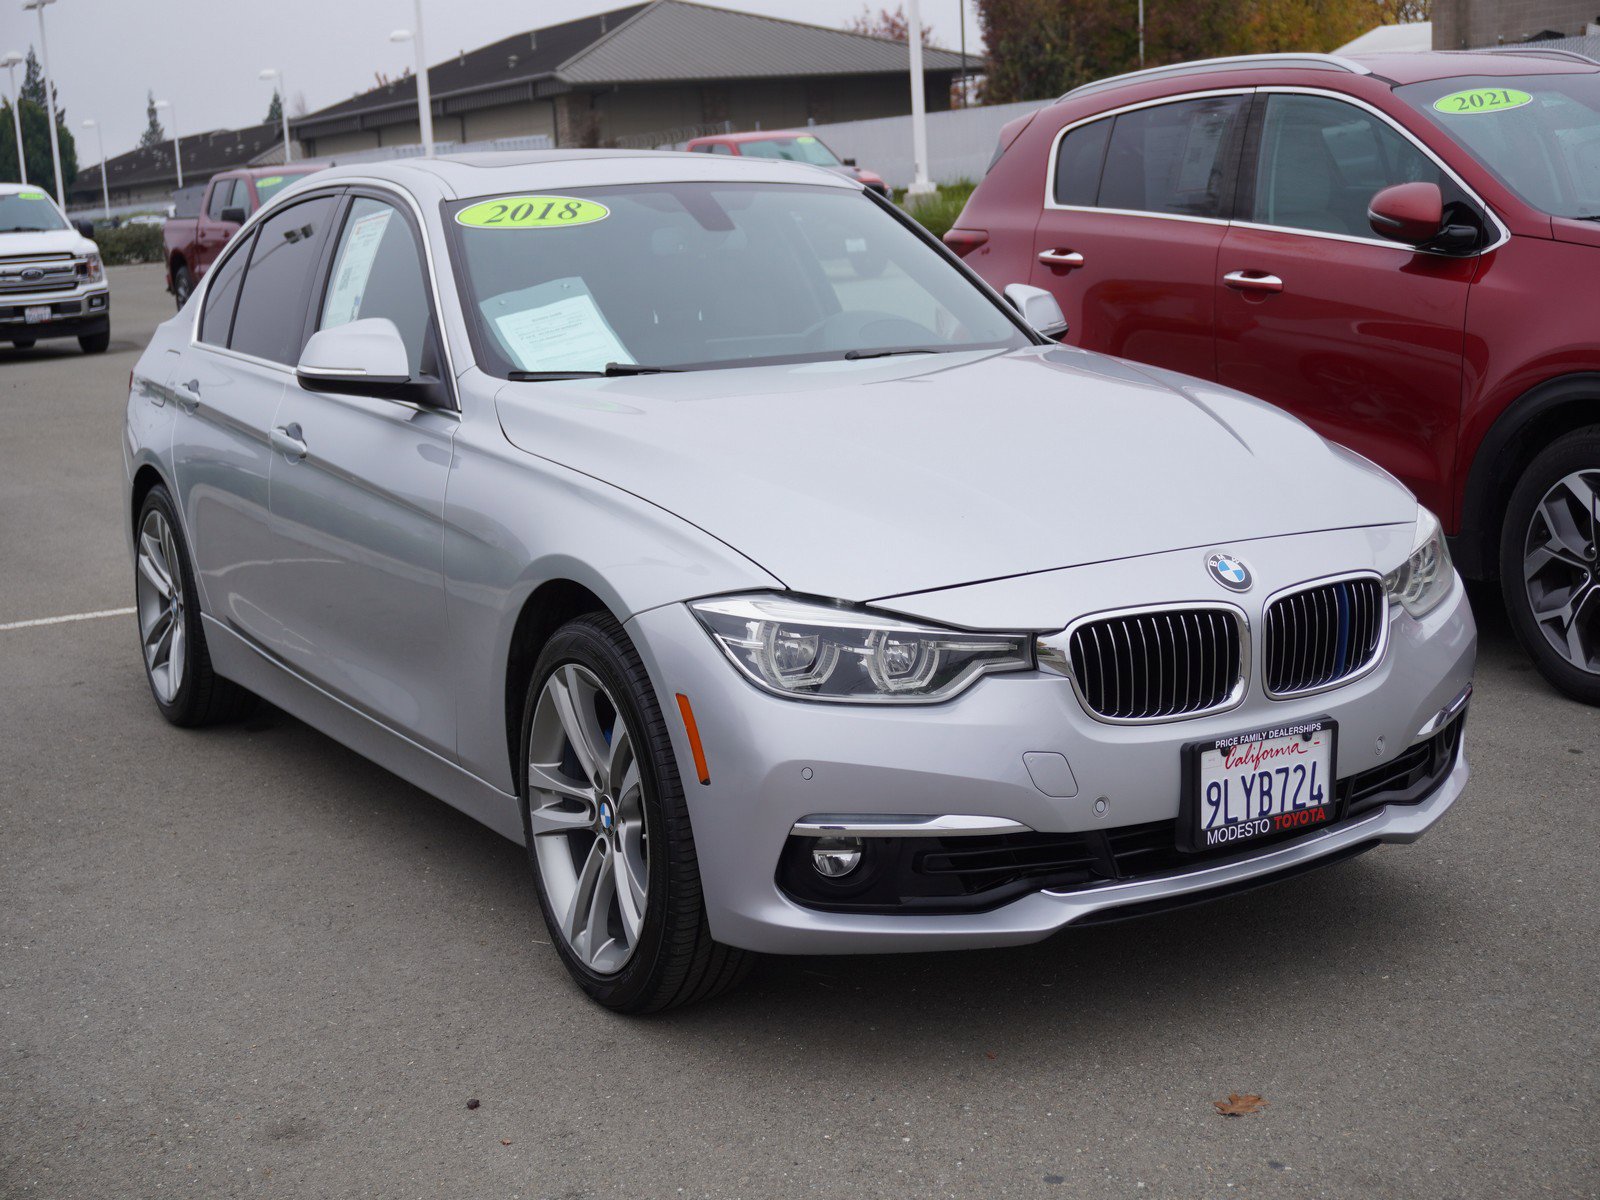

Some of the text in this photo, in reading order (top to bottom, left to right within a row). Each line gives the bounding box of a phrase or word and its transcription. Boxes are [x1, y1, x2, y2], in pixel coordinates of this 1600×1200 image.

[1454, 90, 1512, 111] 2021
[483, 202, 582, 225] 2018
[1215, 722, 1322, 749] PRICE FAMILY DEALERSHIPS
[1225, 737, 1308, 771] California
[1206, 761, 1324, 829] 9LYB724
[1207, 807, 1326, 845] MODESTO TOYOTA
